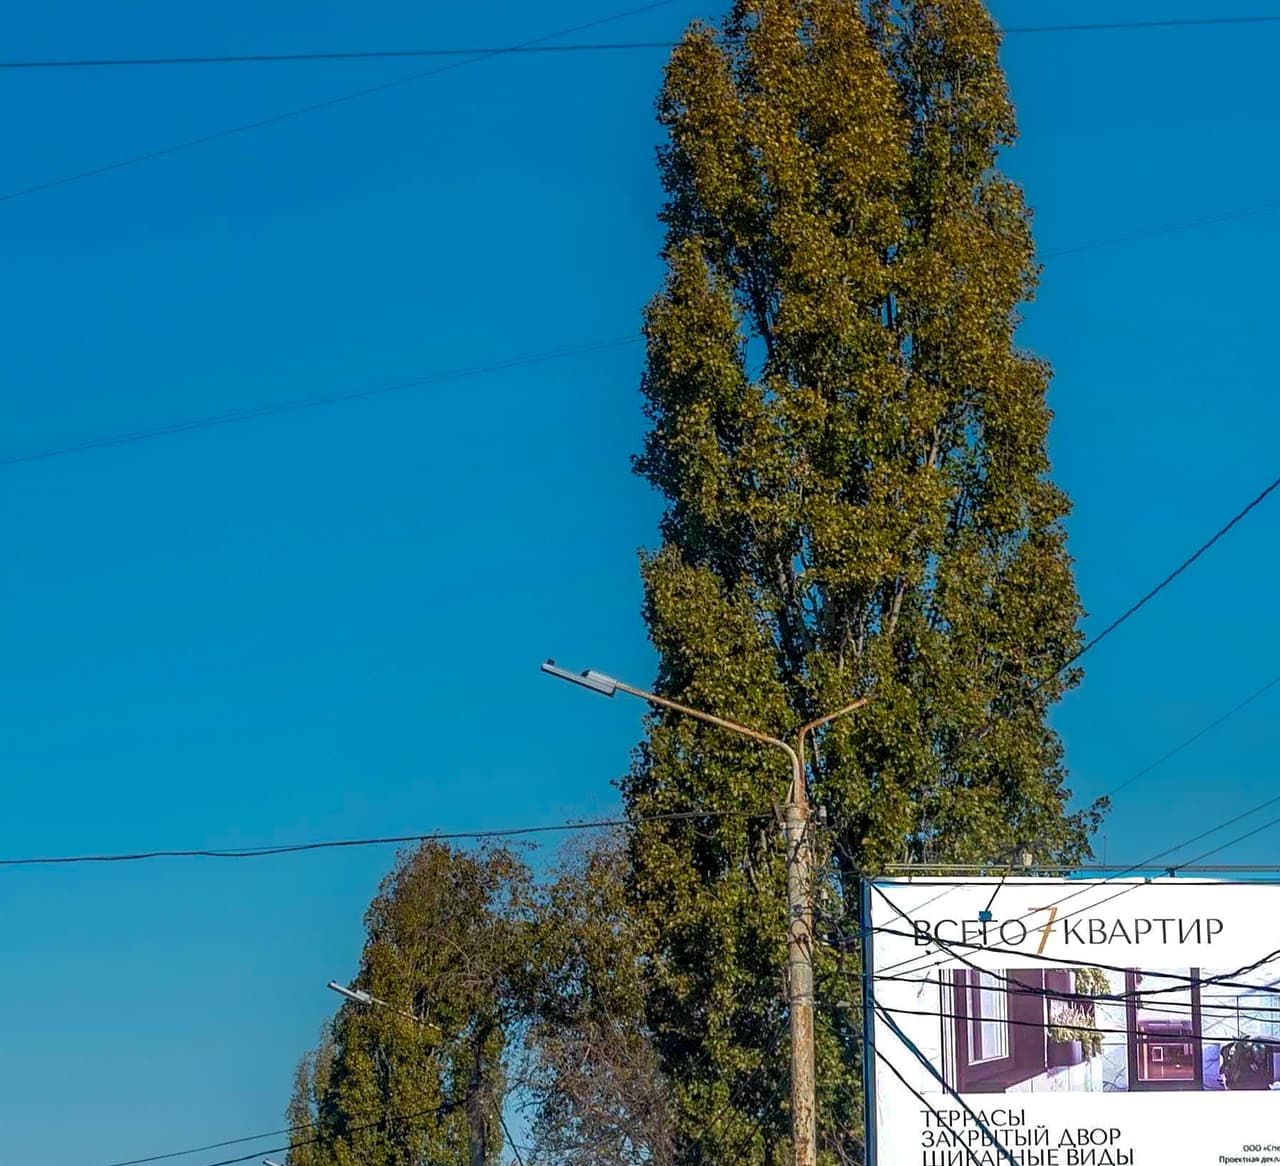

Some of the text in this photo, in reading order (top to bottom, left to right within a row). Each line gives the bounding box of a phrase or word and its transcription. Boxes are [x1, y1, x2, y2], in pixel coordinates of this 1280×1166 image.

[913, 906, 1224, 955] ВСЕГО 7 КВАРТИР
[920, 1108, 1026, 1128] ТЕРРАСЫ
[921, 1125, 1122, 1149] ЗАКРЫТЫЙ ДВОР
[1243, 1144, 1262, 1152] ООО
